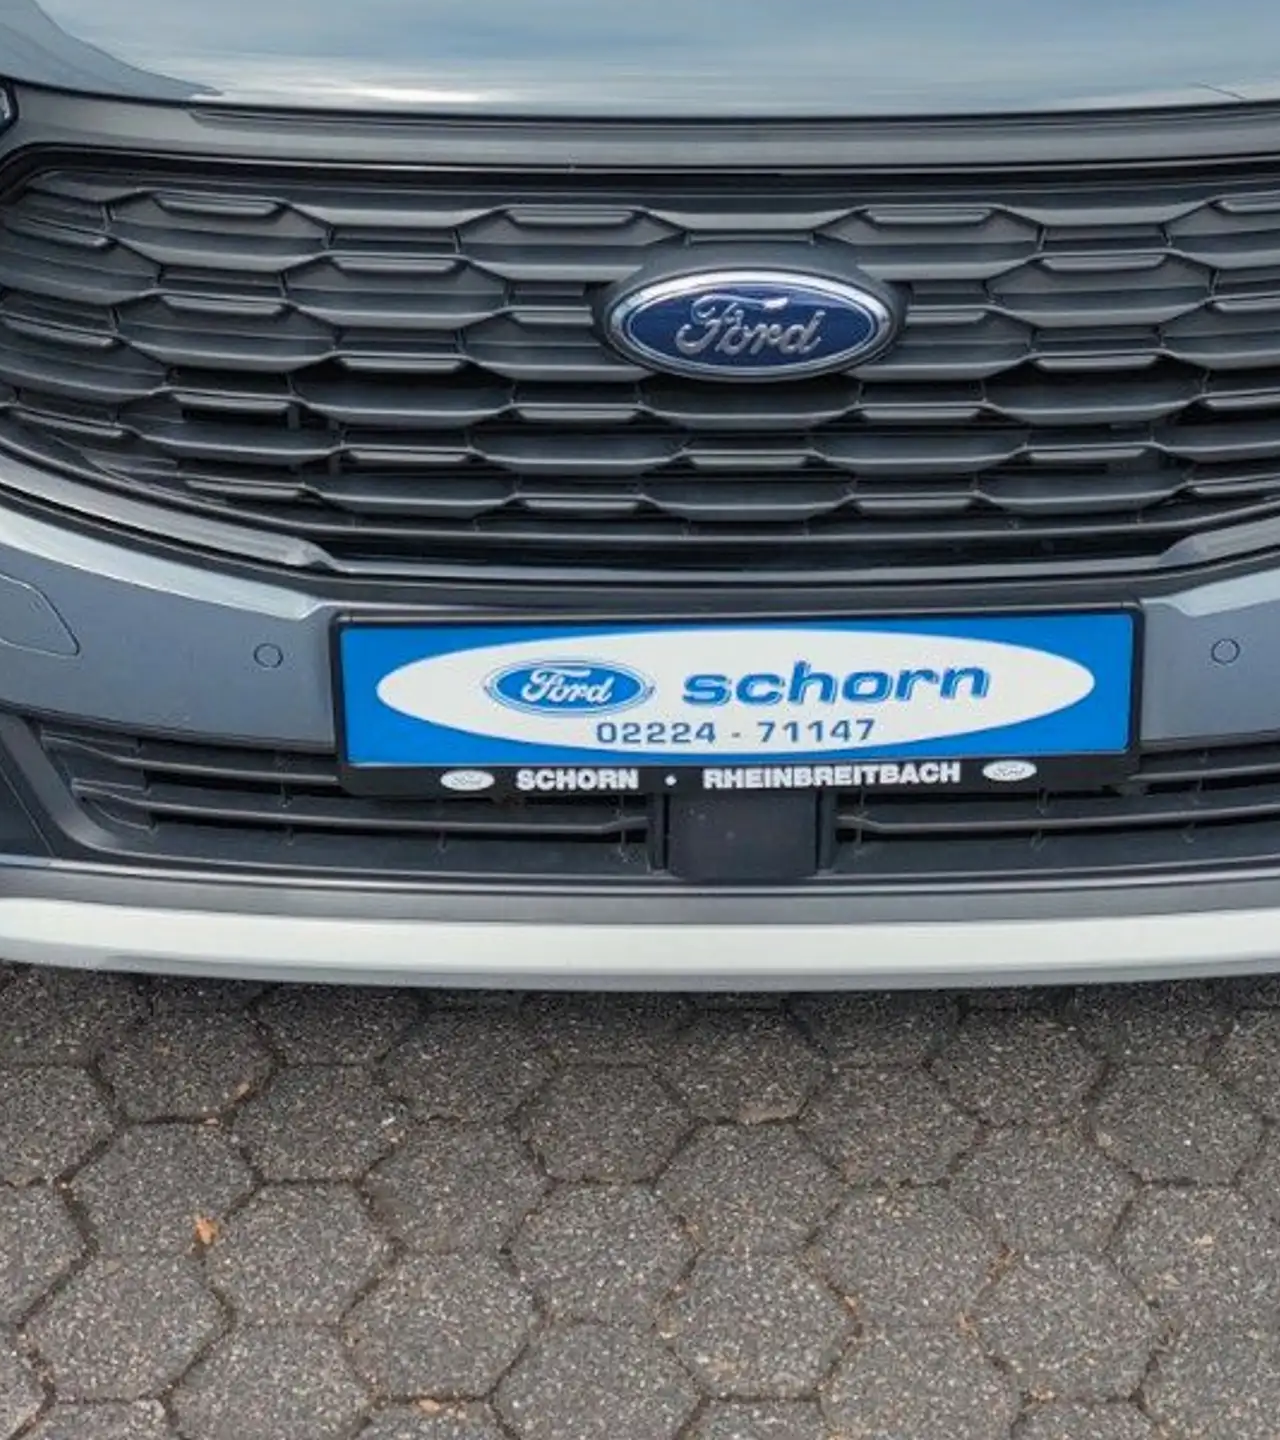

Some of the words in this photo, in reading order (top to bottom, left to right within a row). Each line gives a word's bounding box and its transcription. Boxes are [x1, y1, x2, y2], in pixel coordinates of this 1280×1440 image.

[674, 294, 825, 355] Ford
[520, 667, 613, 703] Ford
[681, 660, 991, 706] schorn
[596, 721, 716, 744] 02224
[757, 718, 876, 744] 71147
[516, 768, 639, 792] SCHORN
[703, 761, 961, 790] RHEINBREITBACH
